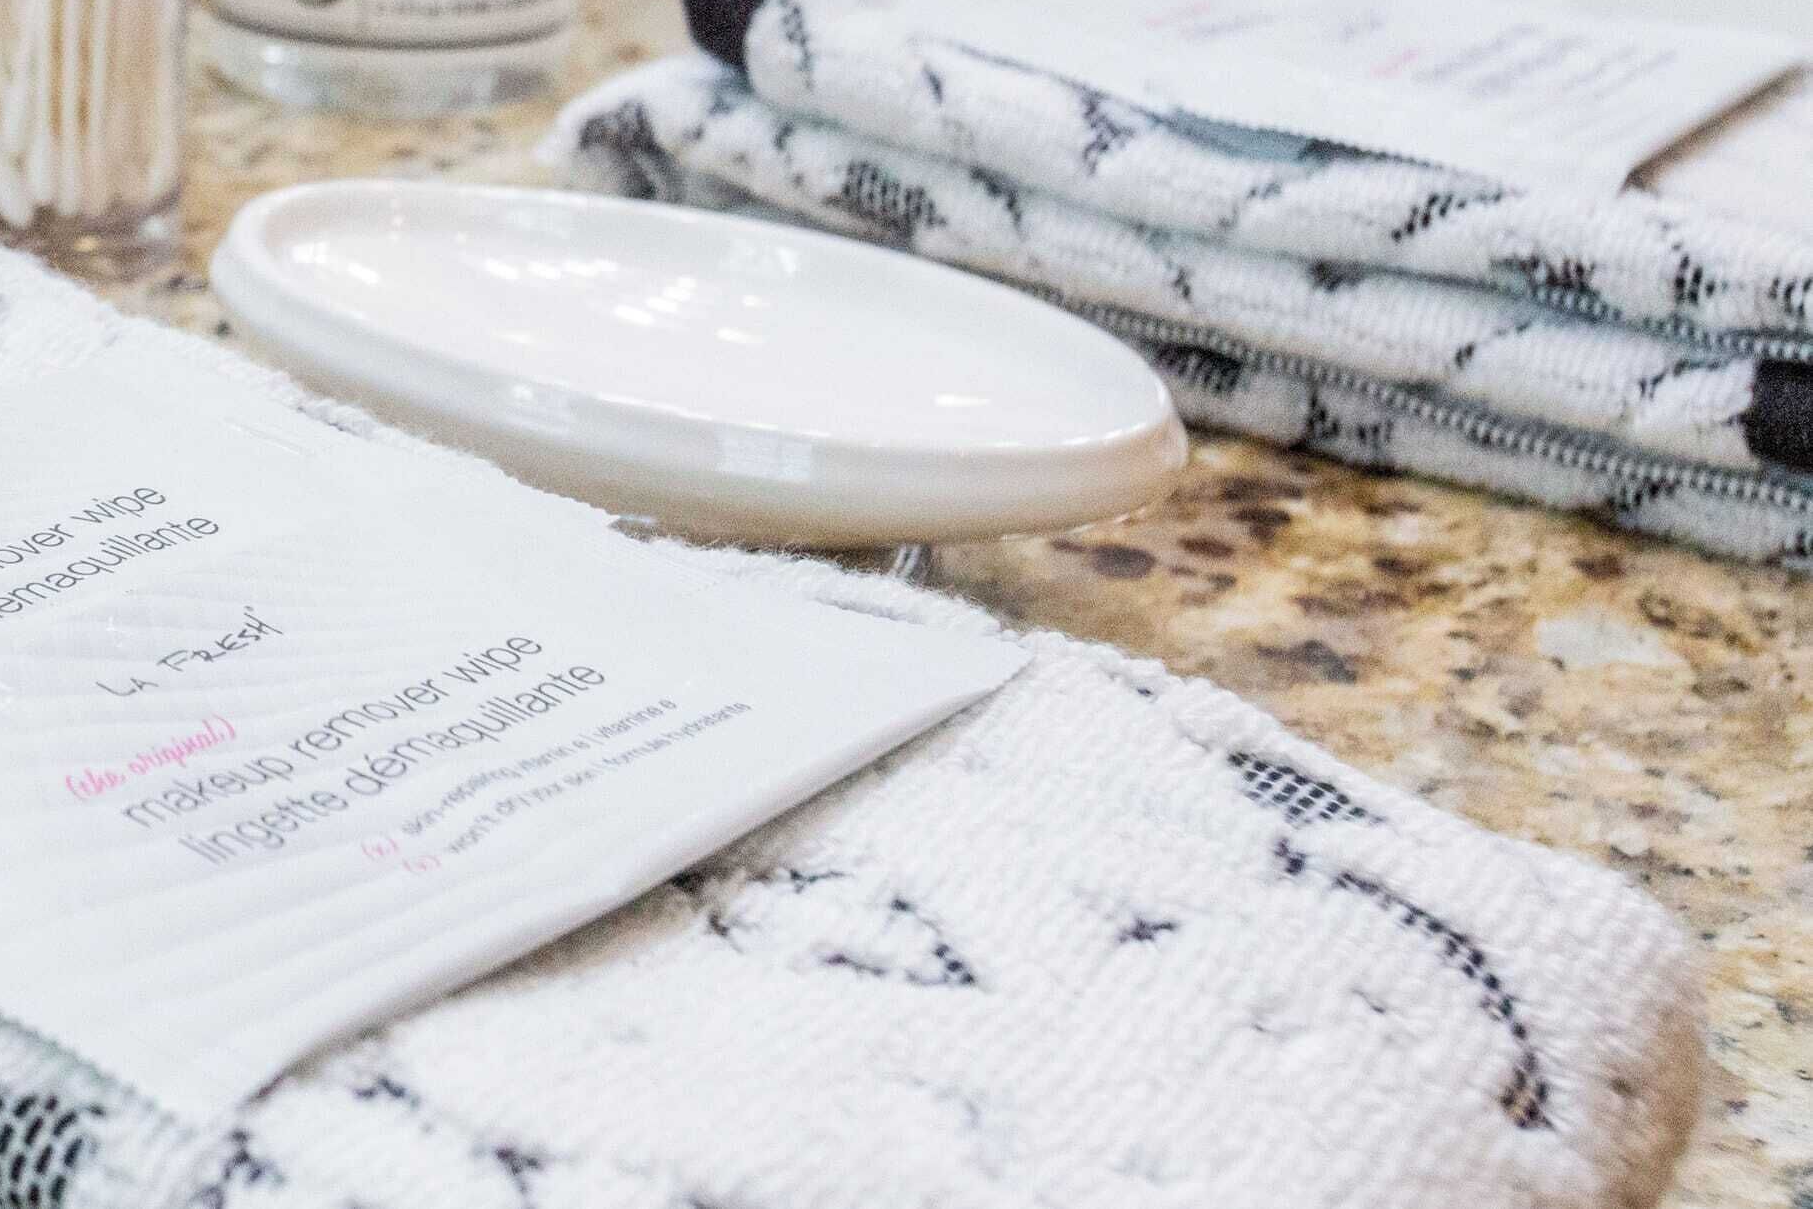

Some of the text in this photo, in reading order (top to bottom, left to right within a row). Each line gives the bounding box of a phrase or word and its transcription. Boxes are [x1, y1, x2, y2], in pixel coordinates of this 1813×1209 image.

[70, 487, 167, 525] wipe
[96, 605, 284, 696] LA FRESH
[120, 633, 544, 829] makeup remover wipe
[178, 663, 606, 866] lingette démaquillante
